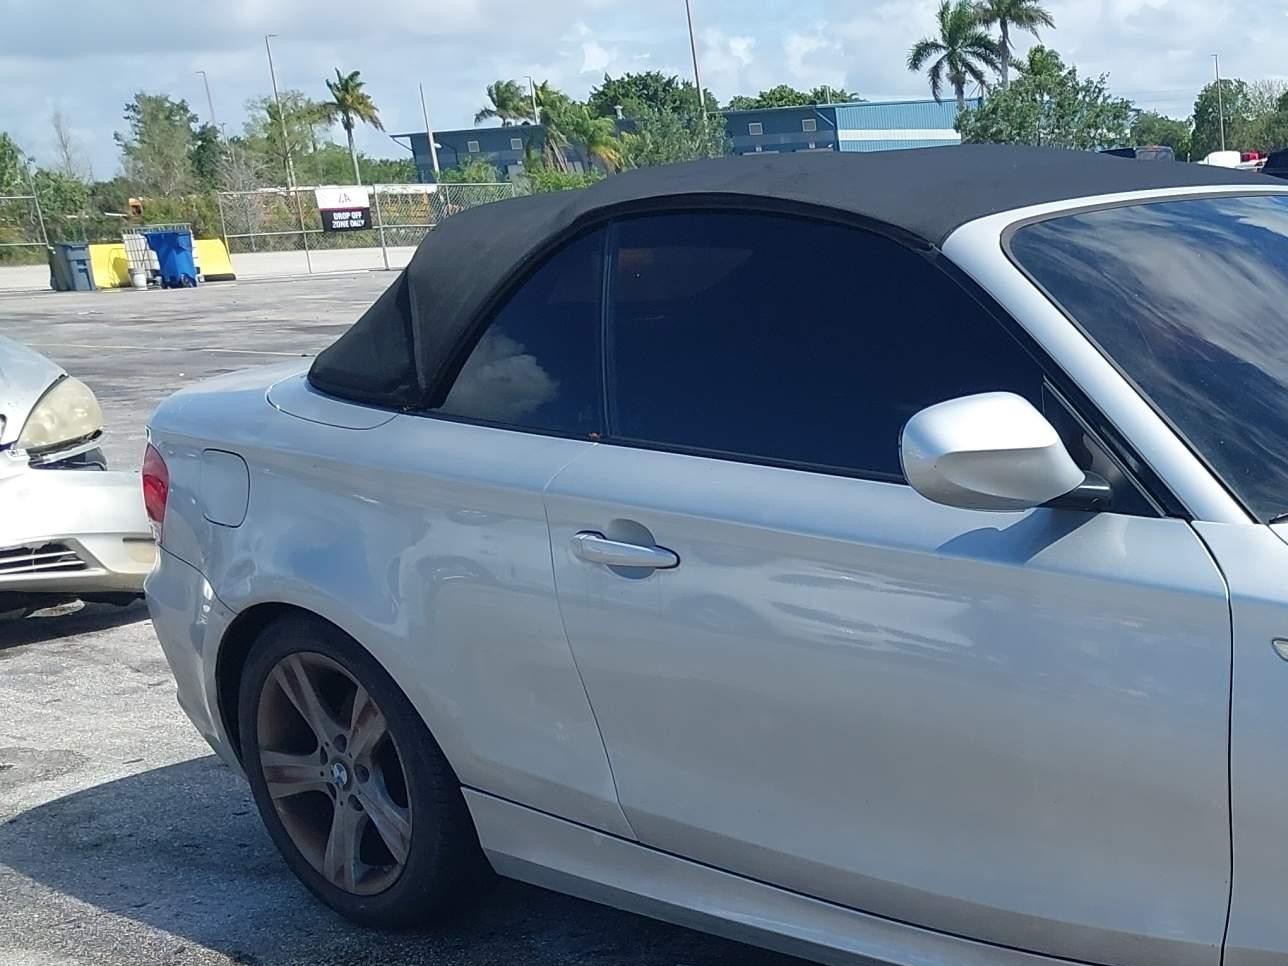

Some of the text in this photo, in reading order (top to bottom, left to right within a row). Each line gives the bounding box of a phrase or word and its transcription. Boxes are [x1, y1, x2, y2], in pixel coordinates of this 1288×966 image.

[333, 211, 362, 220] DROP OFF
[332, 219, 365, 229] ZONE ONLY
